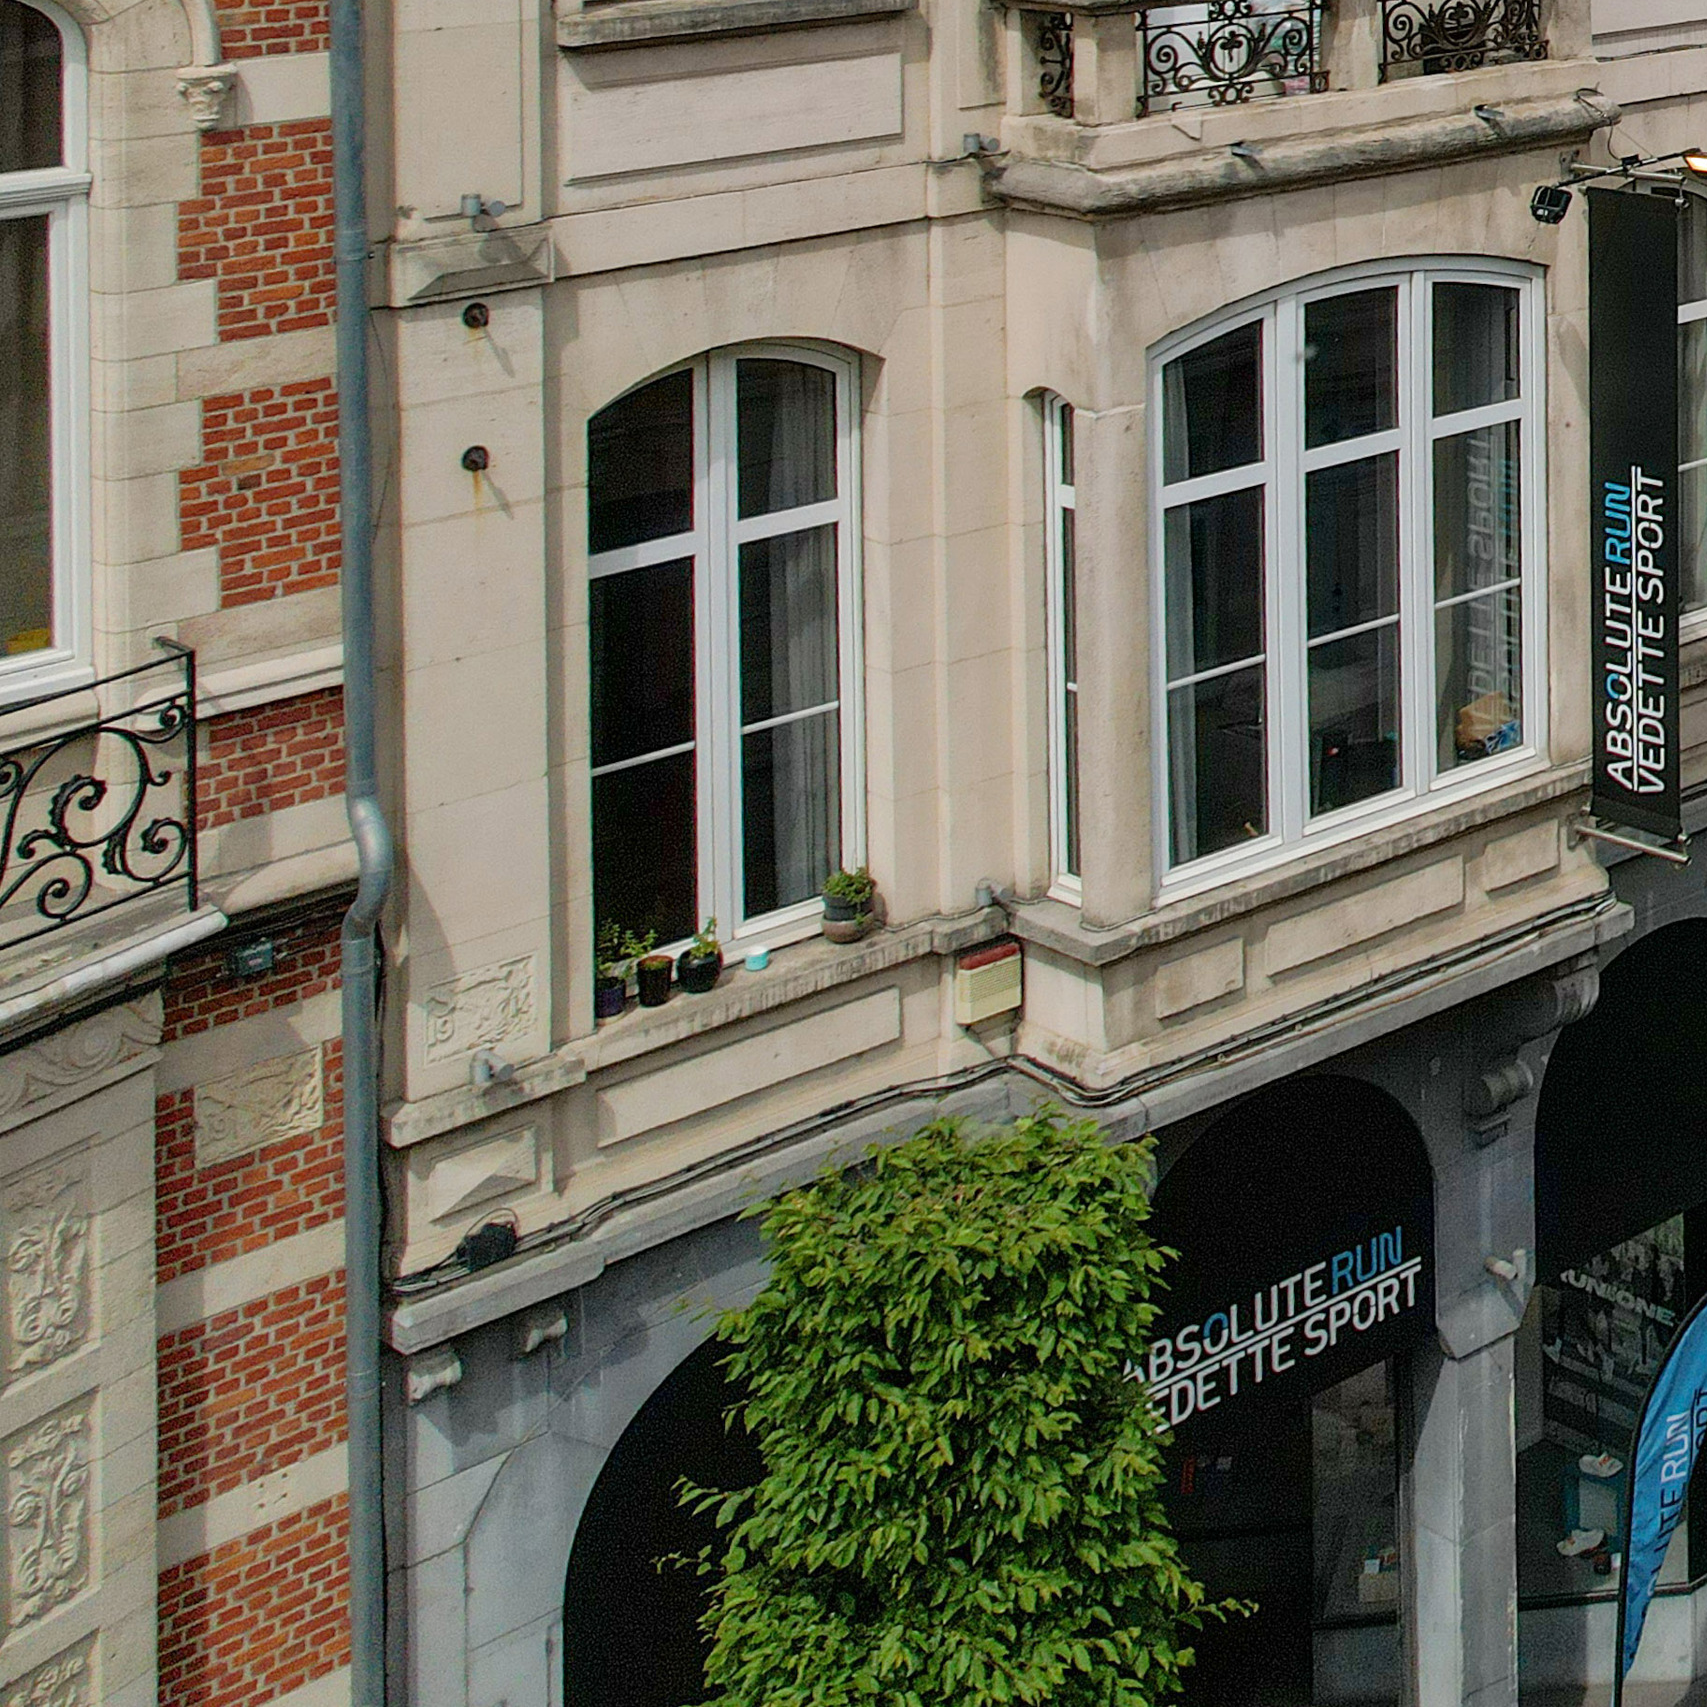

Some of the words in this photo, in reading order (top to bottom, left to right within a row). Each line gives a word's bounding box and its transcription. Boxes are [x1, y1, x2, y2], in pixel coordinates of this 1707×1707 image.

[1604, 481, 1631, 565] RUN
[1637, 466, 1664, 604] SPORT
[1605, 566, 1633, 790] ABSOLUTE
[1638, 610, 1665, 793] VEDETTE
[1331, 1226, 1402, 1294] RUN
[1146, 1326, 1296, 1435] EDETTE
[1303, 1264, 1422, 1357] SPORT
[1661, 1410, 1690, 1484] RUN
